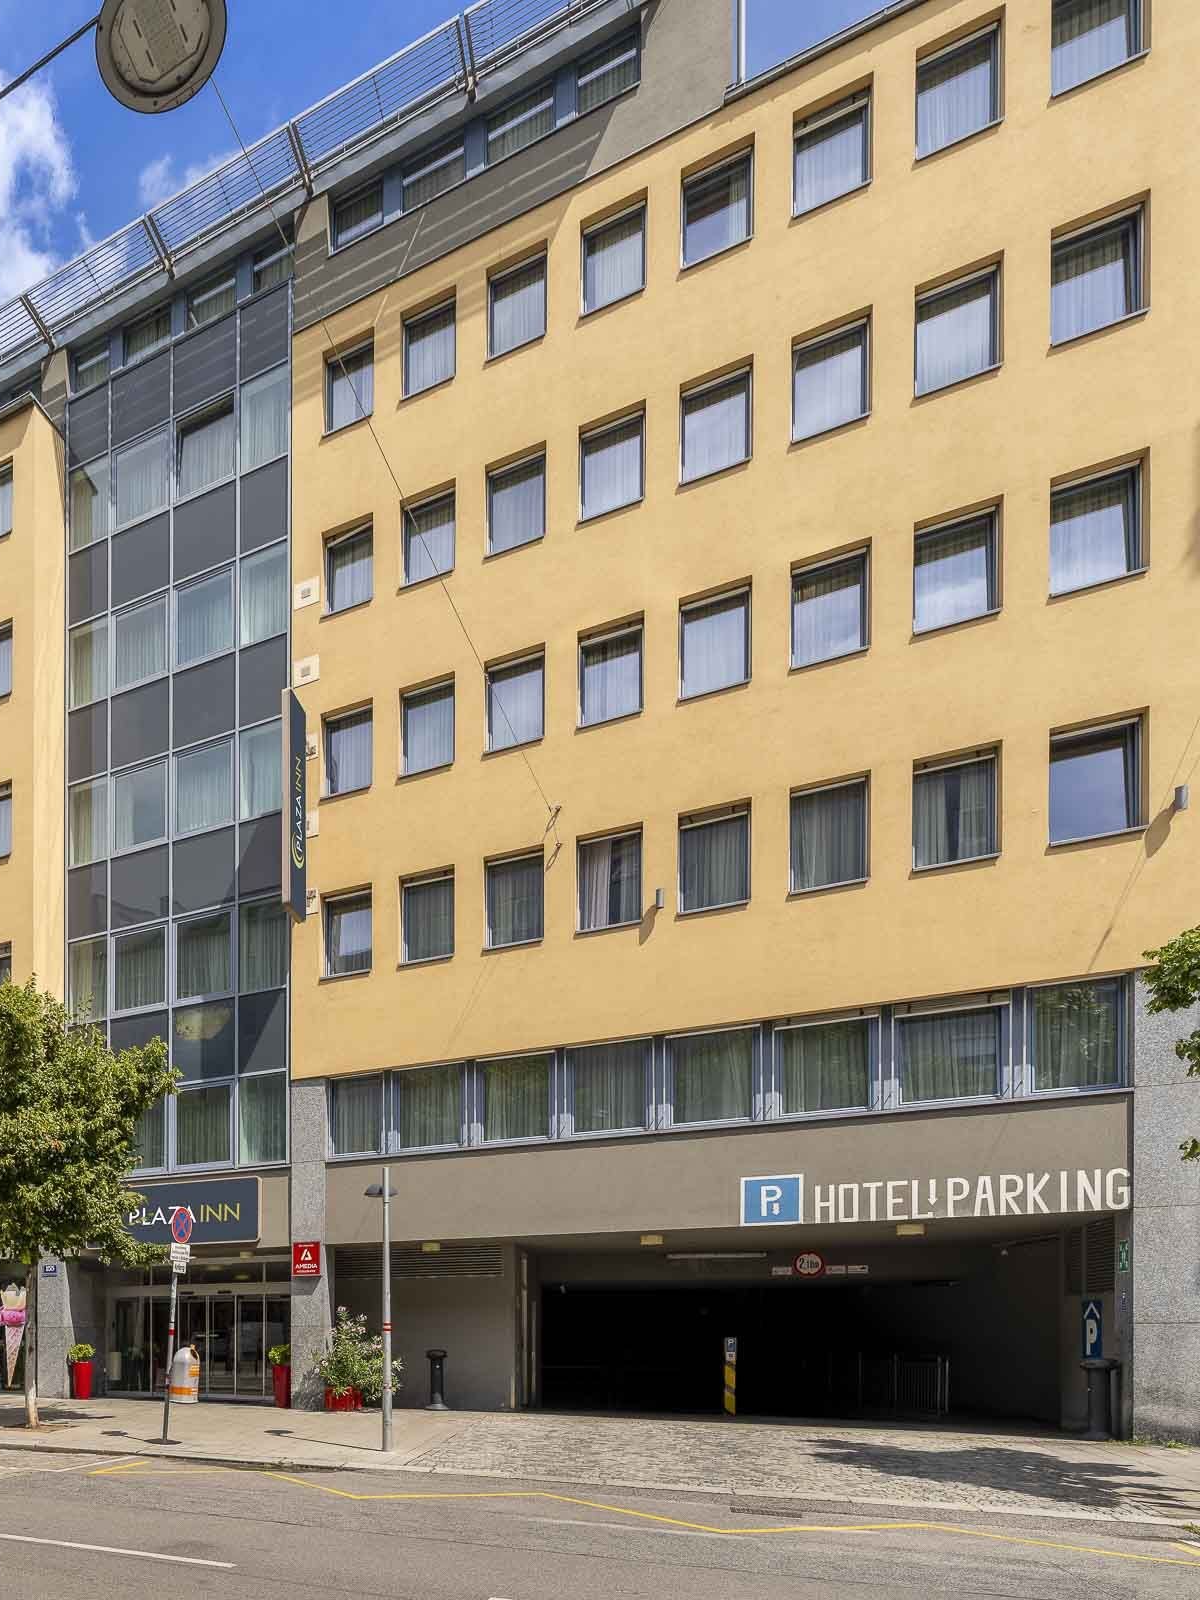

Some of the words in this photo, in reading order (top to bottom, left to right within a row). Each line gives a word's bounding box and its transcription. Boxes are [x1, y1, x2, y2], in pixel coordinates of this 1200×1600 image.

[761, 1185, 782, 1217] P
[814, 1179, 934, 1224] HOTEL
[947, 1168, 1131, 1217] PARKING
[200, 1203, 240, 1223] INN
